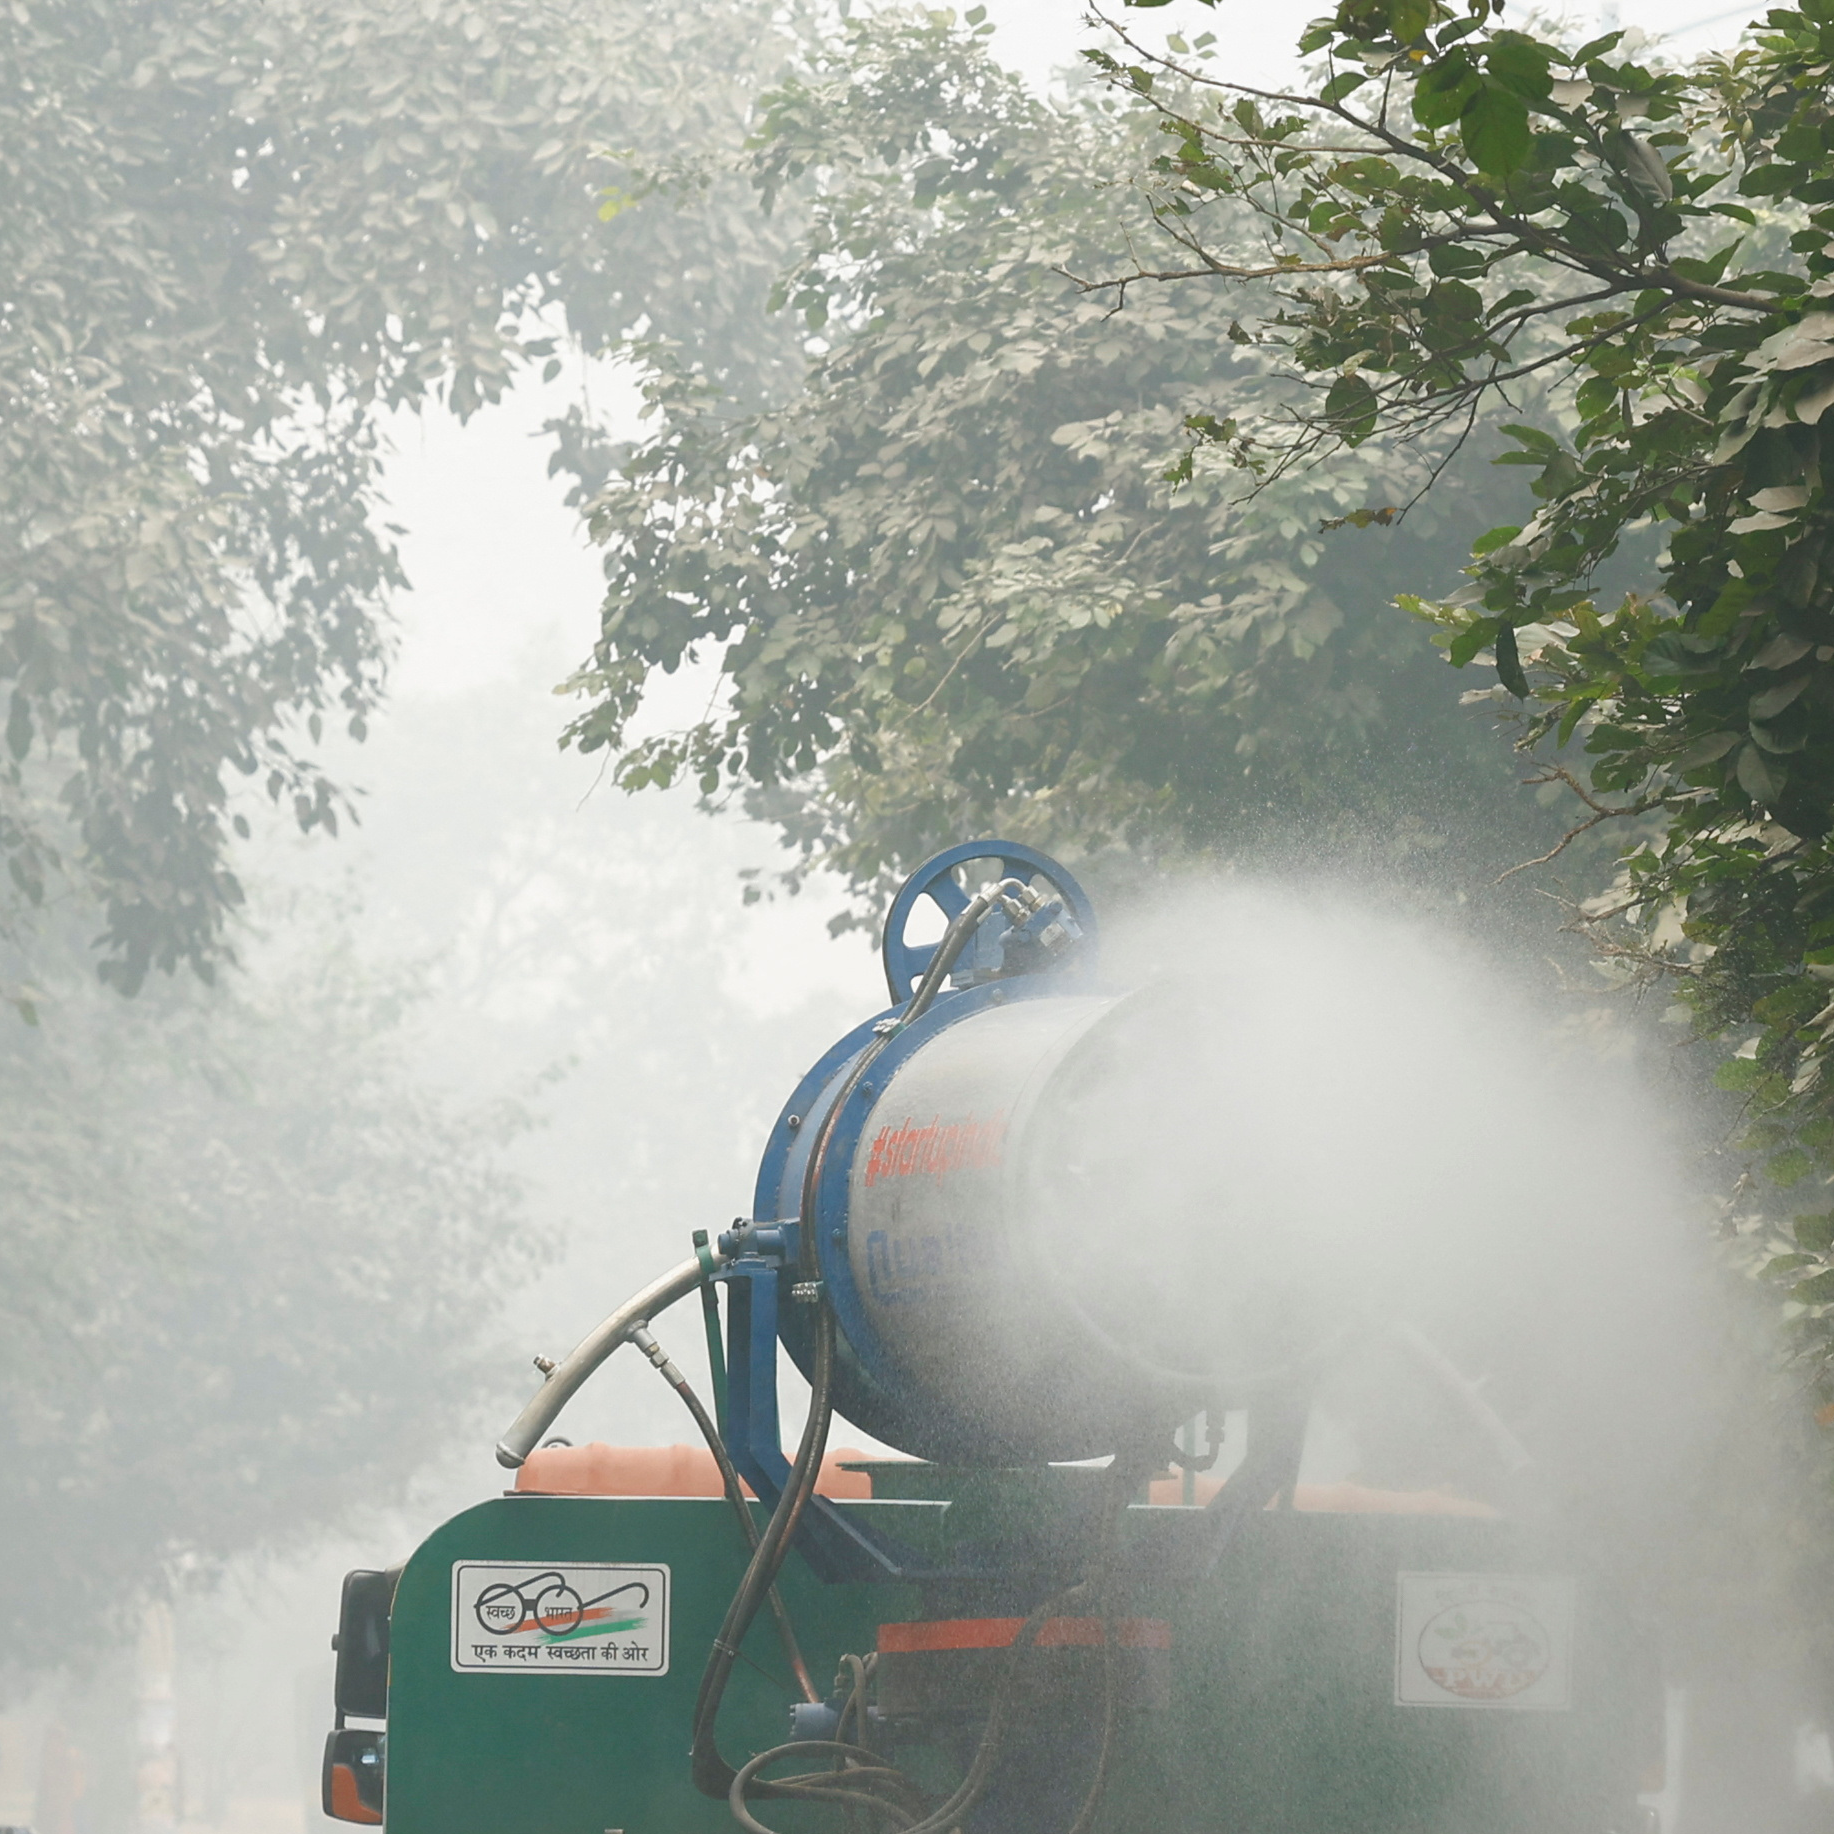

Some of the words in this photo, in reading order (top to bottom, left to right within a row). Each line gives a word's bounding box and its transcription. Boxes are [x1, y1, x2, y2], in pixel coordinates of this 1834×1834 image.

[485, 1604, 516, 1620] स्वच्छ
[544, 1605, 573, 1620] भारत
[471, 1643, 498, 1663] एक
[502, 1644, 541, 1662] कदम
[546, 1645, 597, 1661] स्वच्छता
[600, 1641, 618, 1661] की
[621, 1641, 649, 1661] ओर
